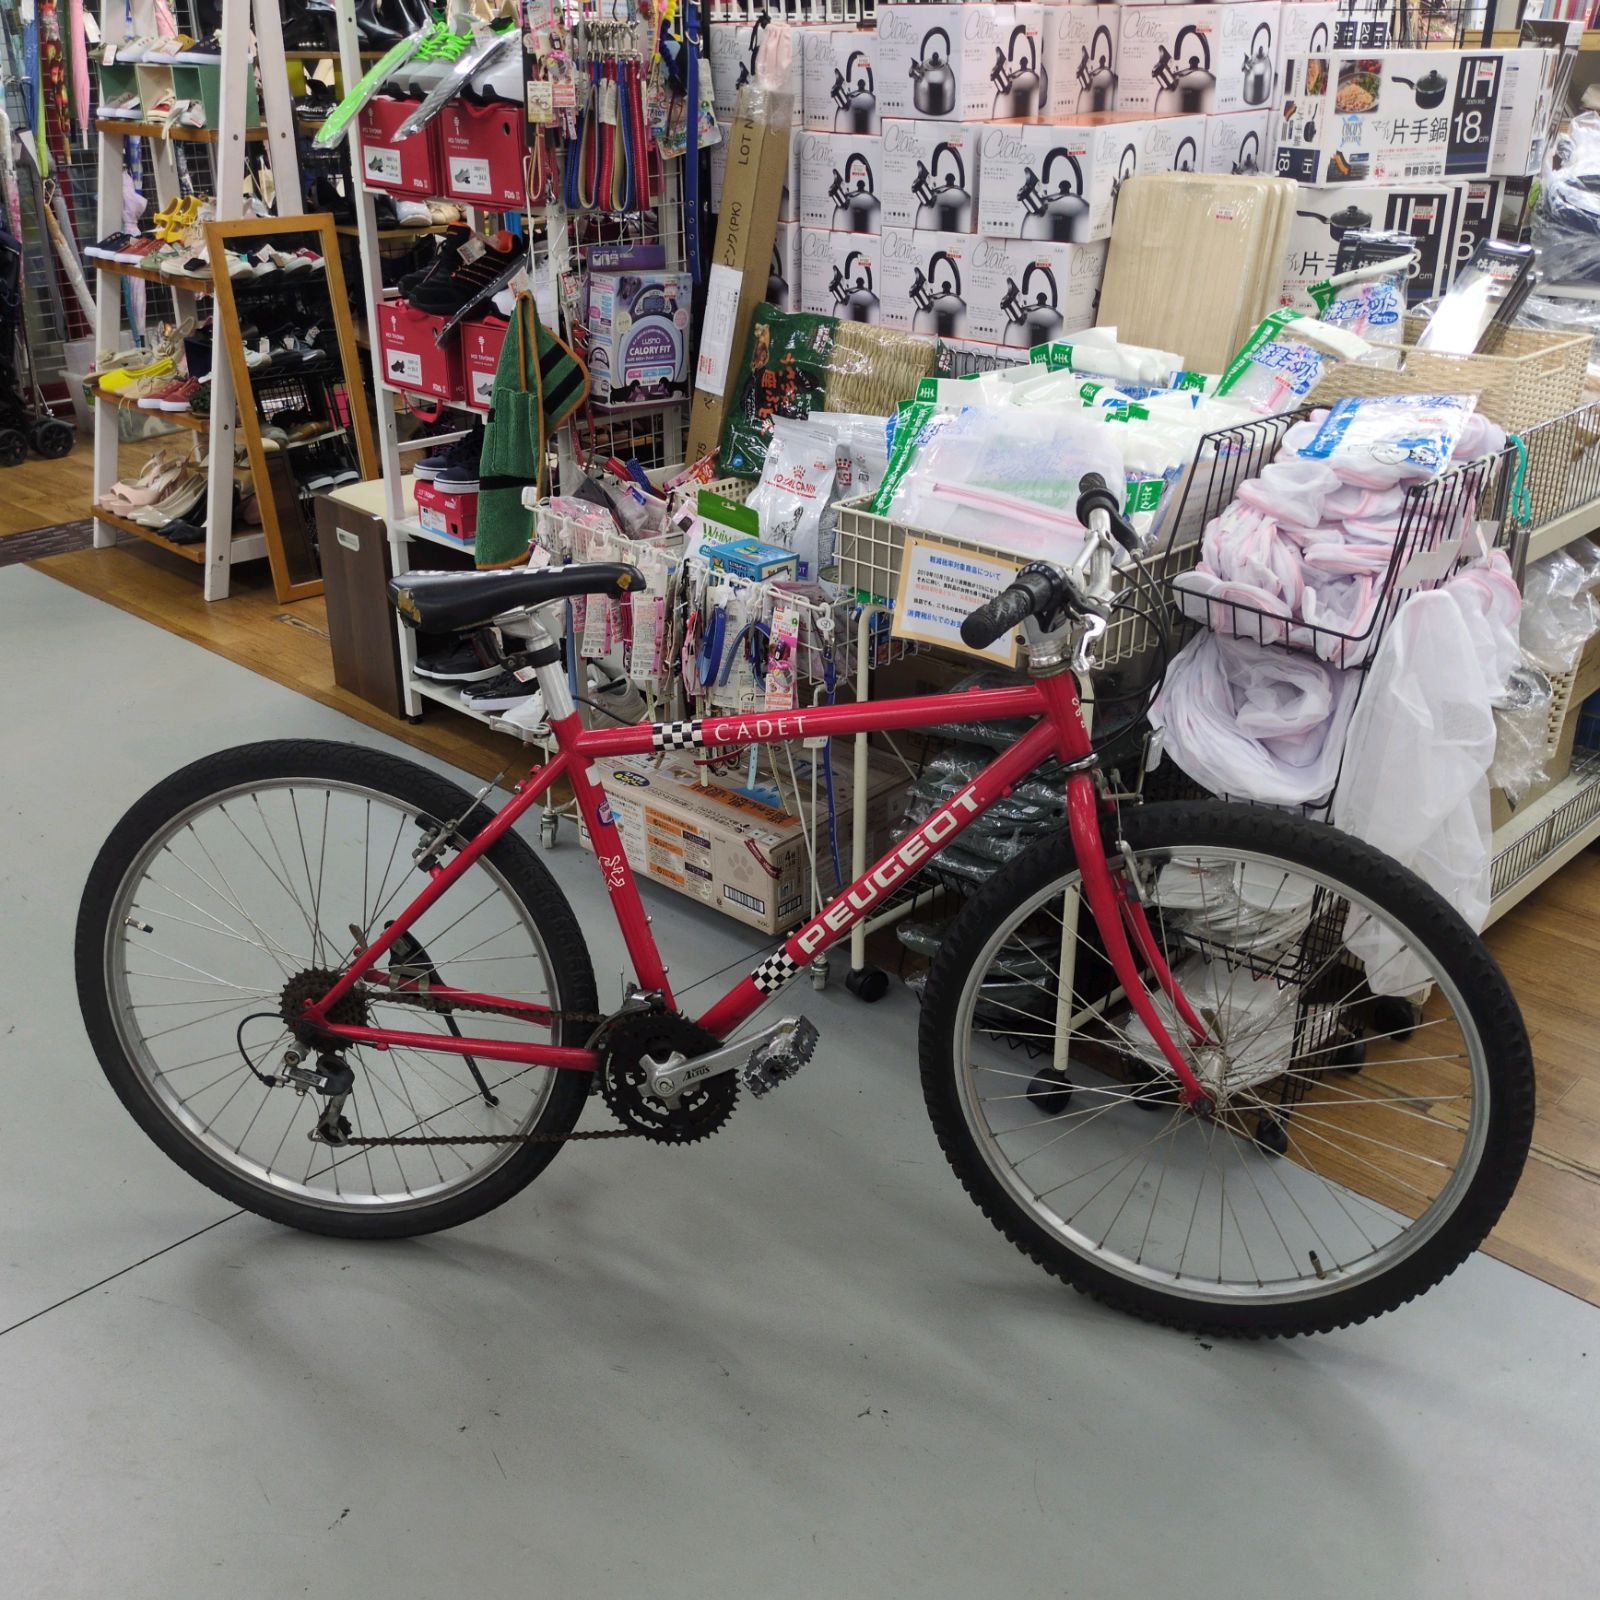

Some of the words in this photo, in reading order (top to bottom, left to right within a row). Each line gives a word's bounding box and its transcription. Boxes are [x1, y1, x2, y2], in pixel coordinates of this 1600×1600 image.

[1460, 59, 1497, 98] IH
[1390, 116, 1448, 145] 片手鍋
[738, 135, 752, 166] LOT
[1278, 151, 1290, 171] 18
[1302, 158, 1312, 174] IH
[629, 346, 659, 356] CALORY
[659, 345, 672, 353] FIT
[715, 716, 806, 741] CADET
[798, 786, 979, 954] PEUGEOT
